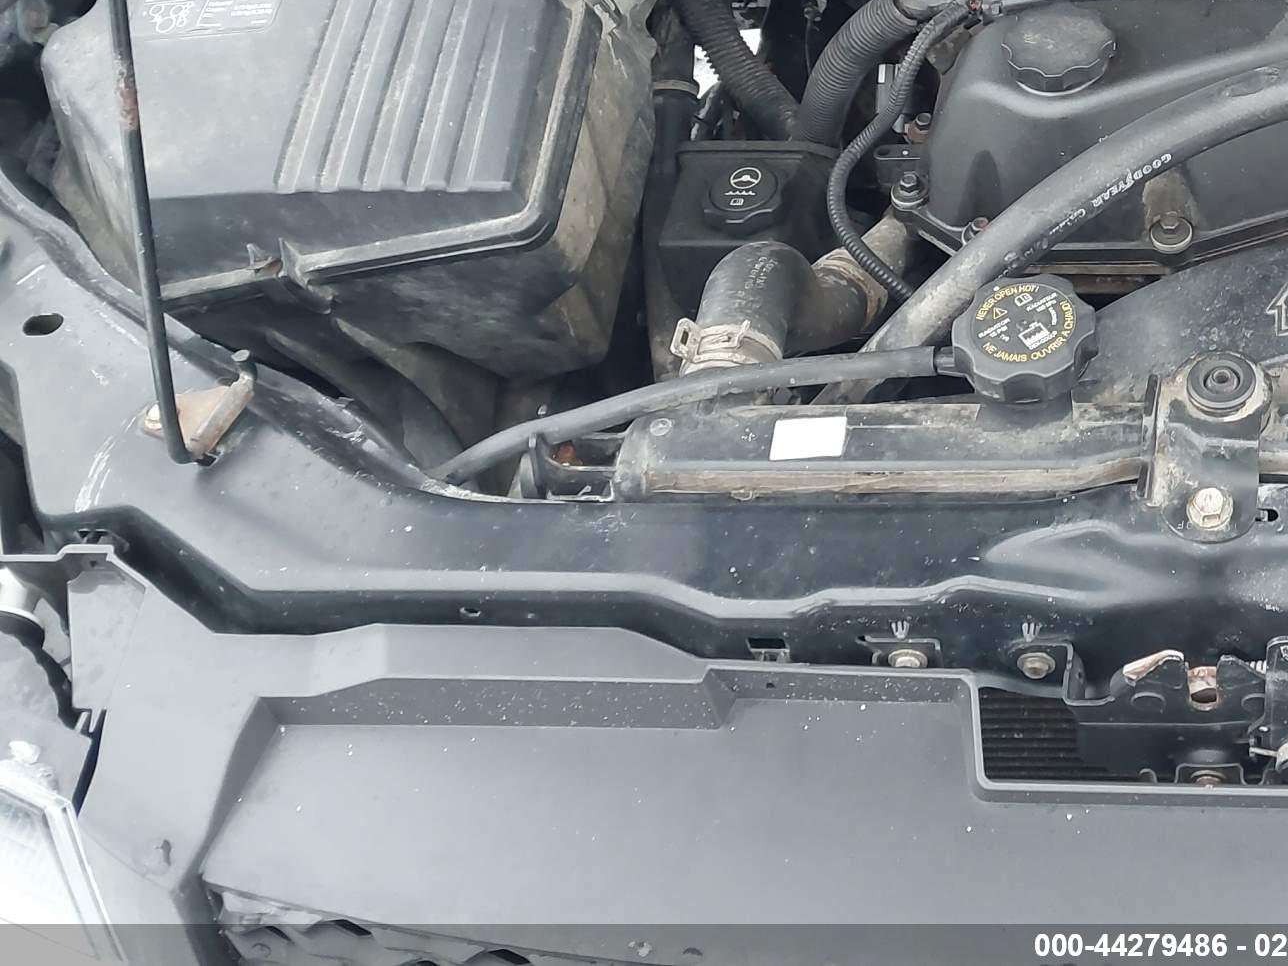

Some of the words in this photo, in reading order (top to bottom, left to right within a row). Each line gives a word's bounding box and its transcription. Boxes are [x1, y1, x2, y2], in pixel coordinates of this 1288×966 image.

[1091, 153, 1172, 208] GOODYEAR
[976, 296, 998, 321] NEVER
[994, 285, 1018, 301] OPEN
[1018, 284, 1040, 293] HOT!
[983, 341, 998, 355] NE
[994, 350, 1028, 362] JAMAIS
[1030, 336, 1067, 360] OUVRIR
